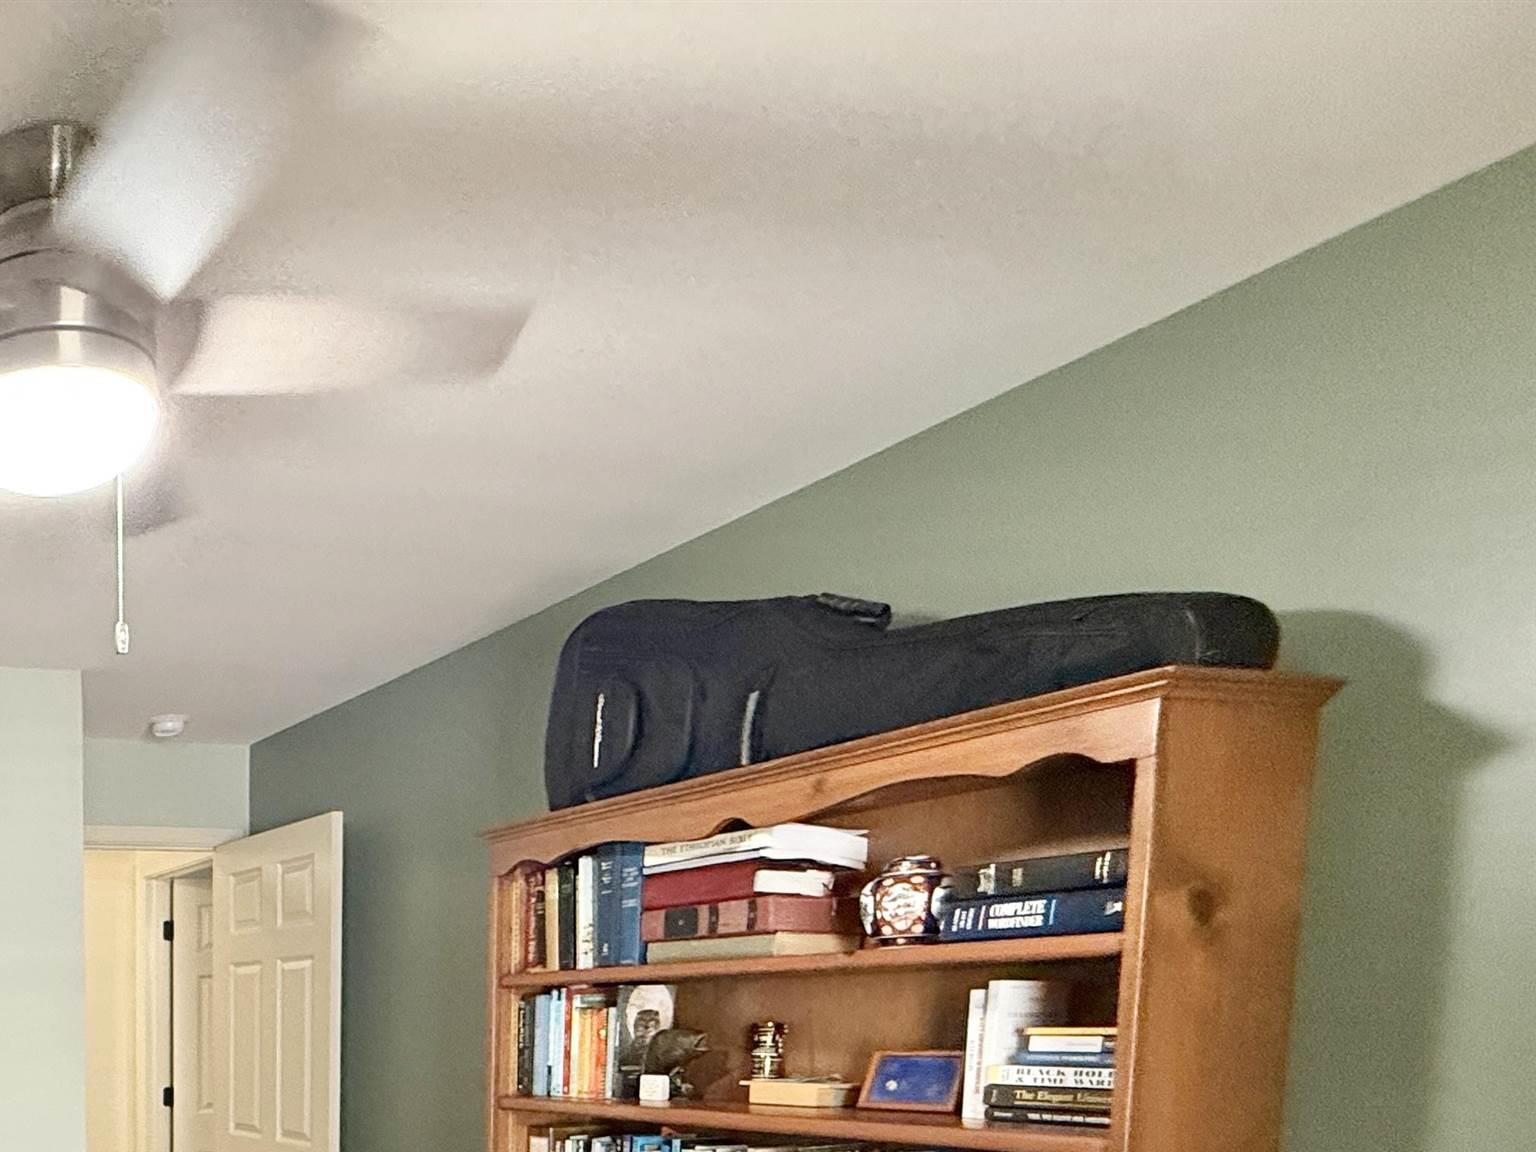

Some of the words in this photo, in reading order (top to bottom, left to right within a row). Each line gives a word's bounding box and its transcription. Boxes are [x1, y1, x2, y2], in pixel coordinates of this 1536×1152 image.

[989, 899, 1048, 917] COMPLETE
[1016, 1068, 1066, 1076] BLACK
[1074, 1069, 1113, 1078] HOLE
[1014, 1090, 1035, 1100] The
